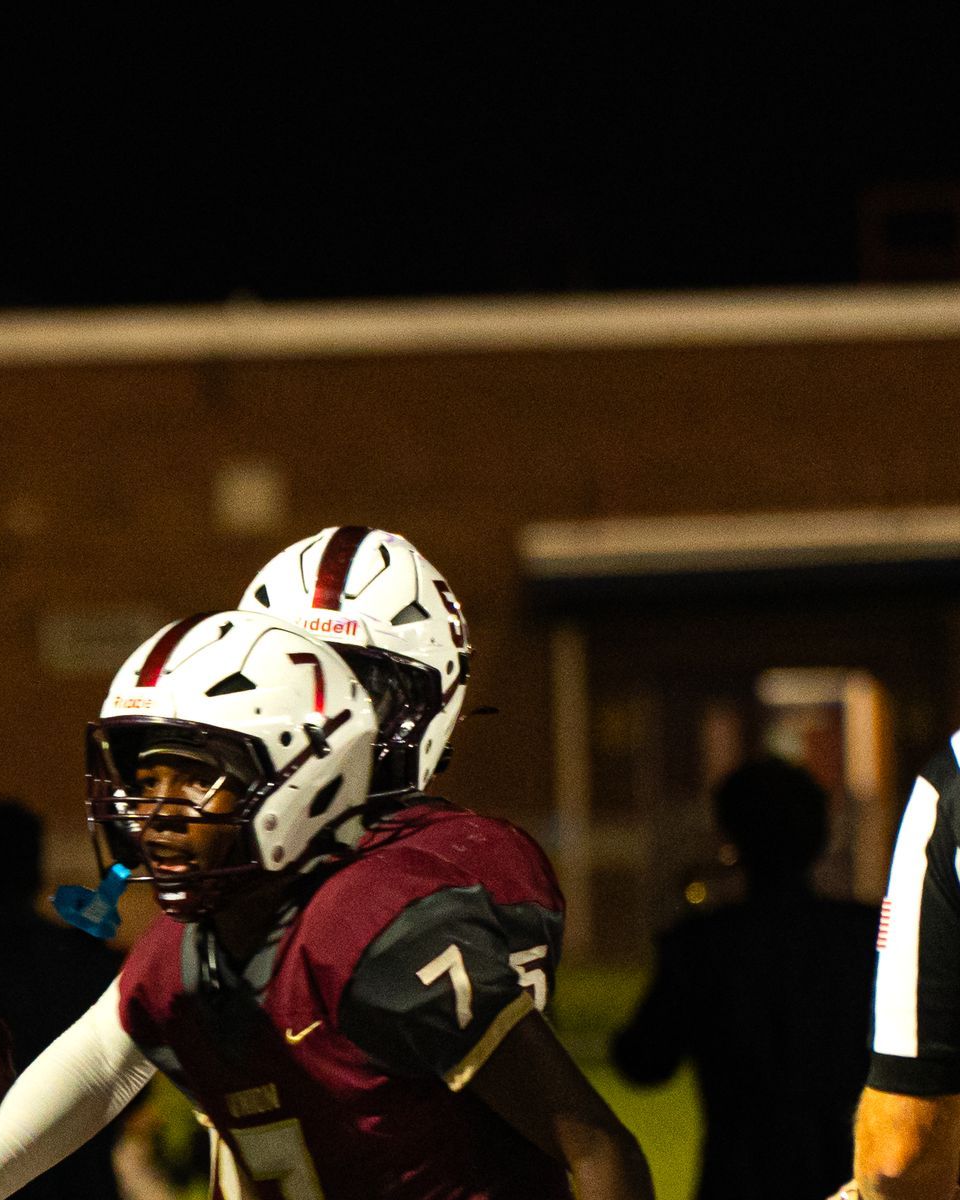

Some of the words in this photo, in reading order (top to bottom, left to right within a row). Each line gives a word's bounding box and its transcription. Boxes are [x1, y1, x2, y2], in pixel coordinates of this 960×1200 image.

[288, 653, 325, 714] 7
[416, 943, 473, 1029] 7
[509, 944, 548, 1012] 5
